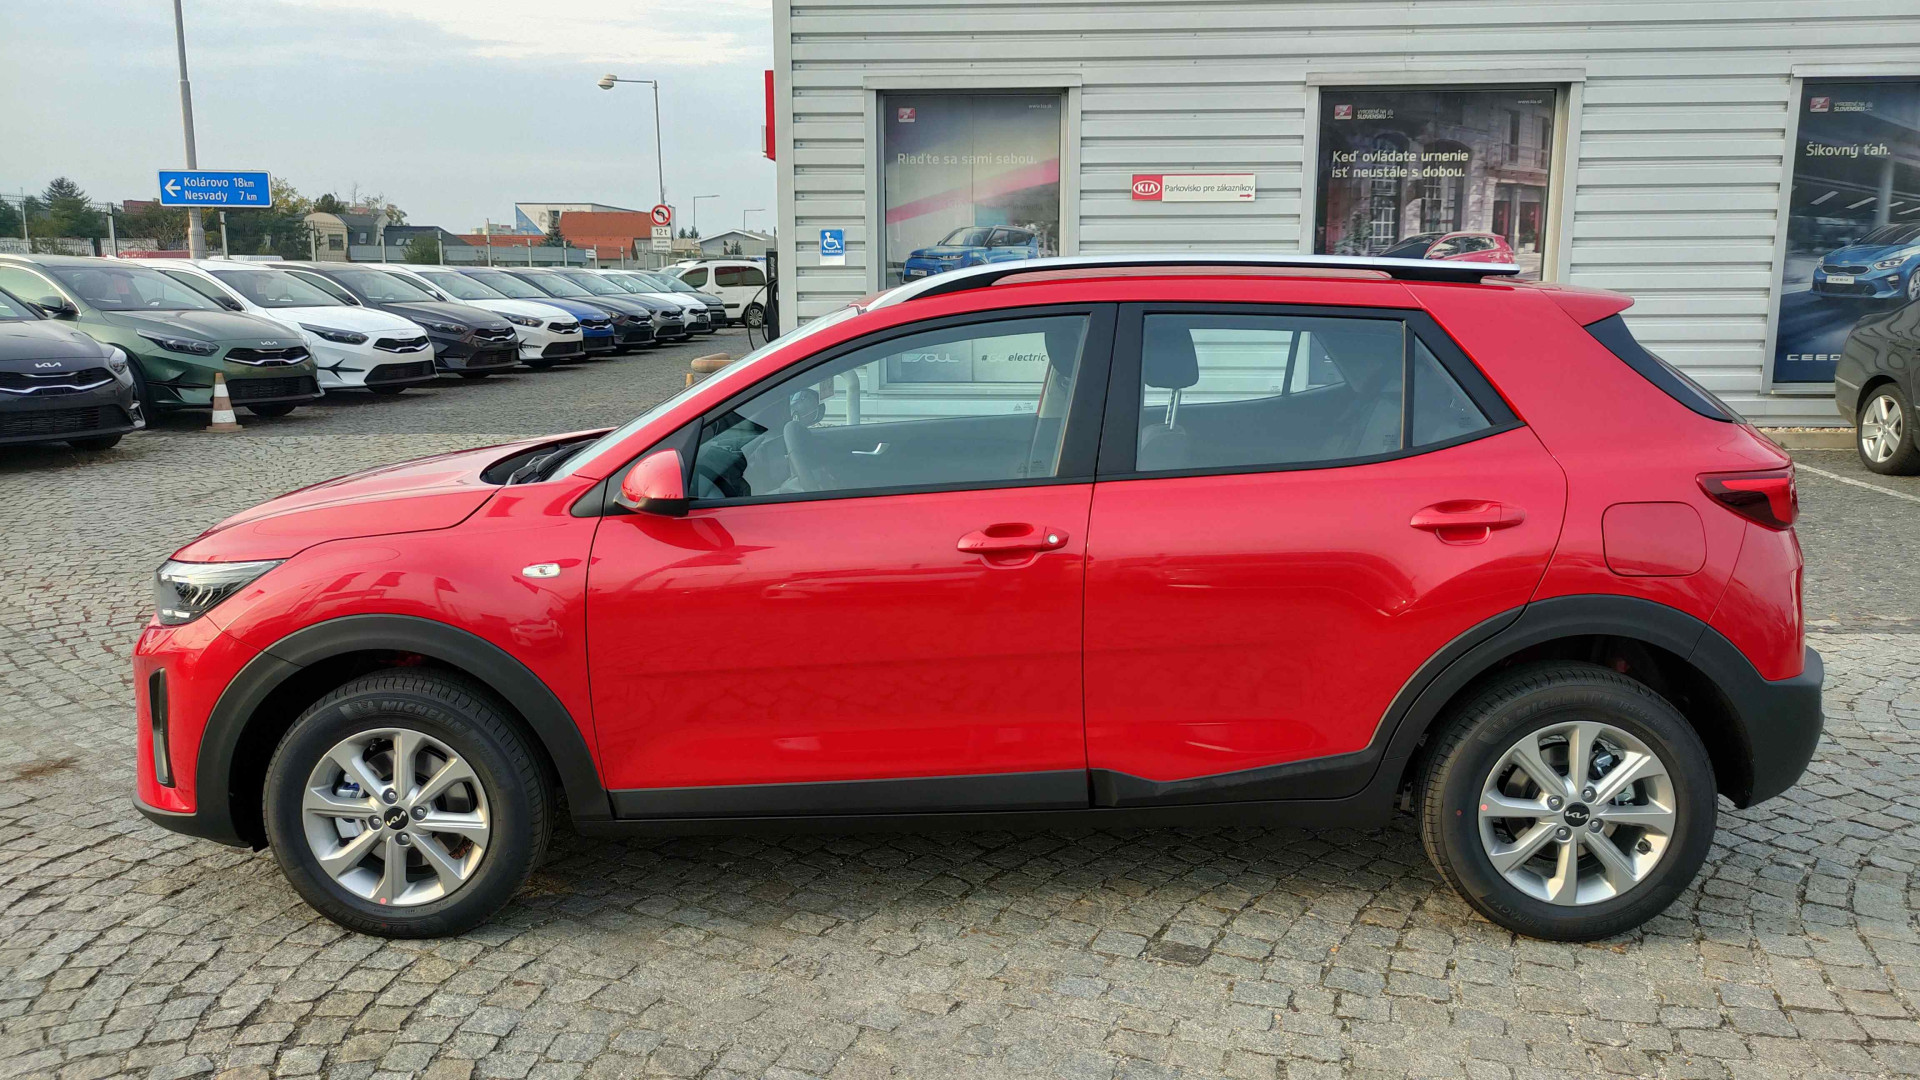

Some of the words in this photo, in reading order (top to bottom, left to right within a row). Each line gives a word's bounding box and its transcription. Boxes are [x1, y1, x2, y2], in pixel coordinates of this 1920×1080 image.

[1805, 141, 1859, 158] Šikovný
[1863, 143, 1891, 156] ťah.
[897, 153, 940, 165] Riaďte
[943, 156, 958, 164] sa
[961, 153, 992, 164] sami
[996, 153, 1038, 165] sebou.
[1332, 151, 1359, 162] Keď
[1362, 150, 1417, 162] ovládate
[1331, 166, 1350, 178] ísť
[1353, 166, 1407, 177] neustále
[1411, 168, 1419, 177] s
[1422, 166, 1466, 177] dobou.
[183, 177, 229, 187] Kolárovo
[233, 178, 243, 188] 18
[243, 180, 255, 188] km
[1137, 184, 1156, 193] KIA
[1164, 184, 1201, 192] Parkovisko
[1203, 185, 1215, 193] pre
[1216, 184, 1254, 192] zákazníkov
[184, 191, 228, 202] Nesvady
[239, 191, 245, 201] 7
[246, 193, 258, 201] km
[381, 701, 467, 731] MICHELIN
